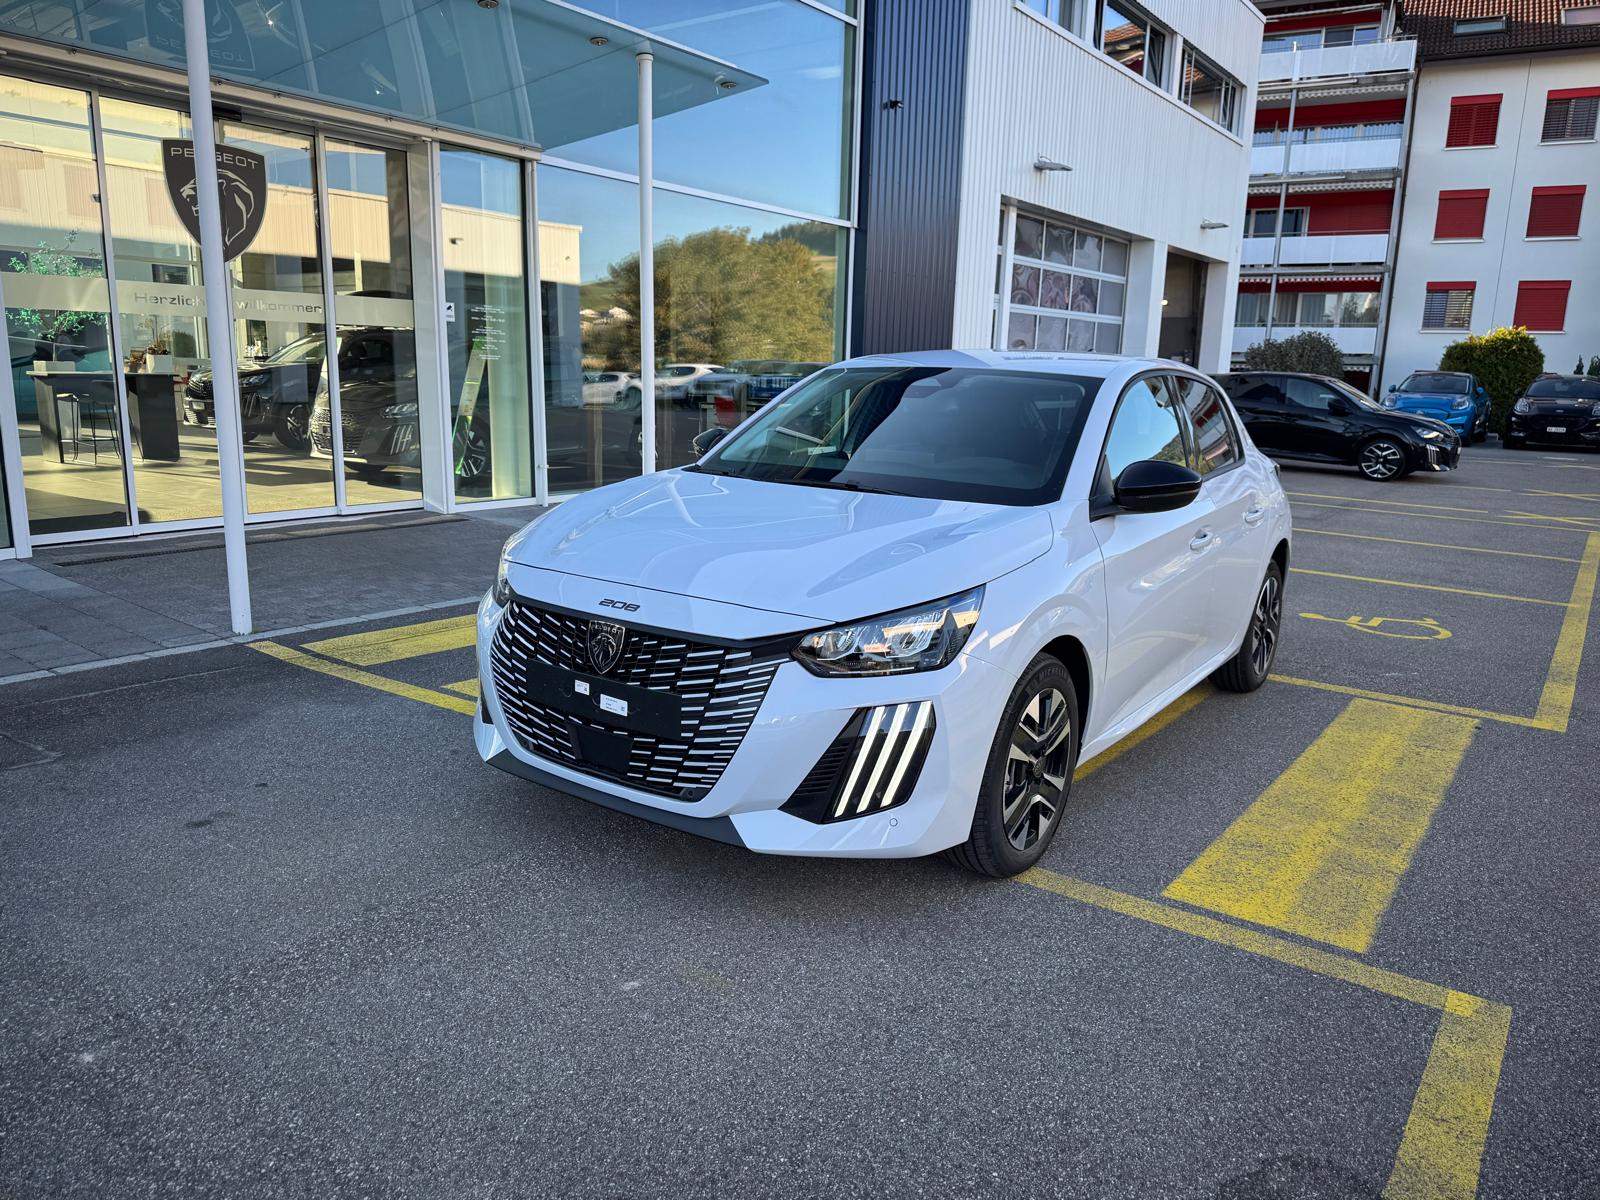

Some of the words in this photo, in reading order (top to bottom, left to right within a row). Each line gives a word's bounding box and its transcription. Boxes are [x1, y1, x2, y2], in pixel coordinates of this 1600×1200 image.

[170, 147, 258, 169] PEGEOT
[235, 297, 323, 314] willkommen
[599, 598, 640, 612] 208
